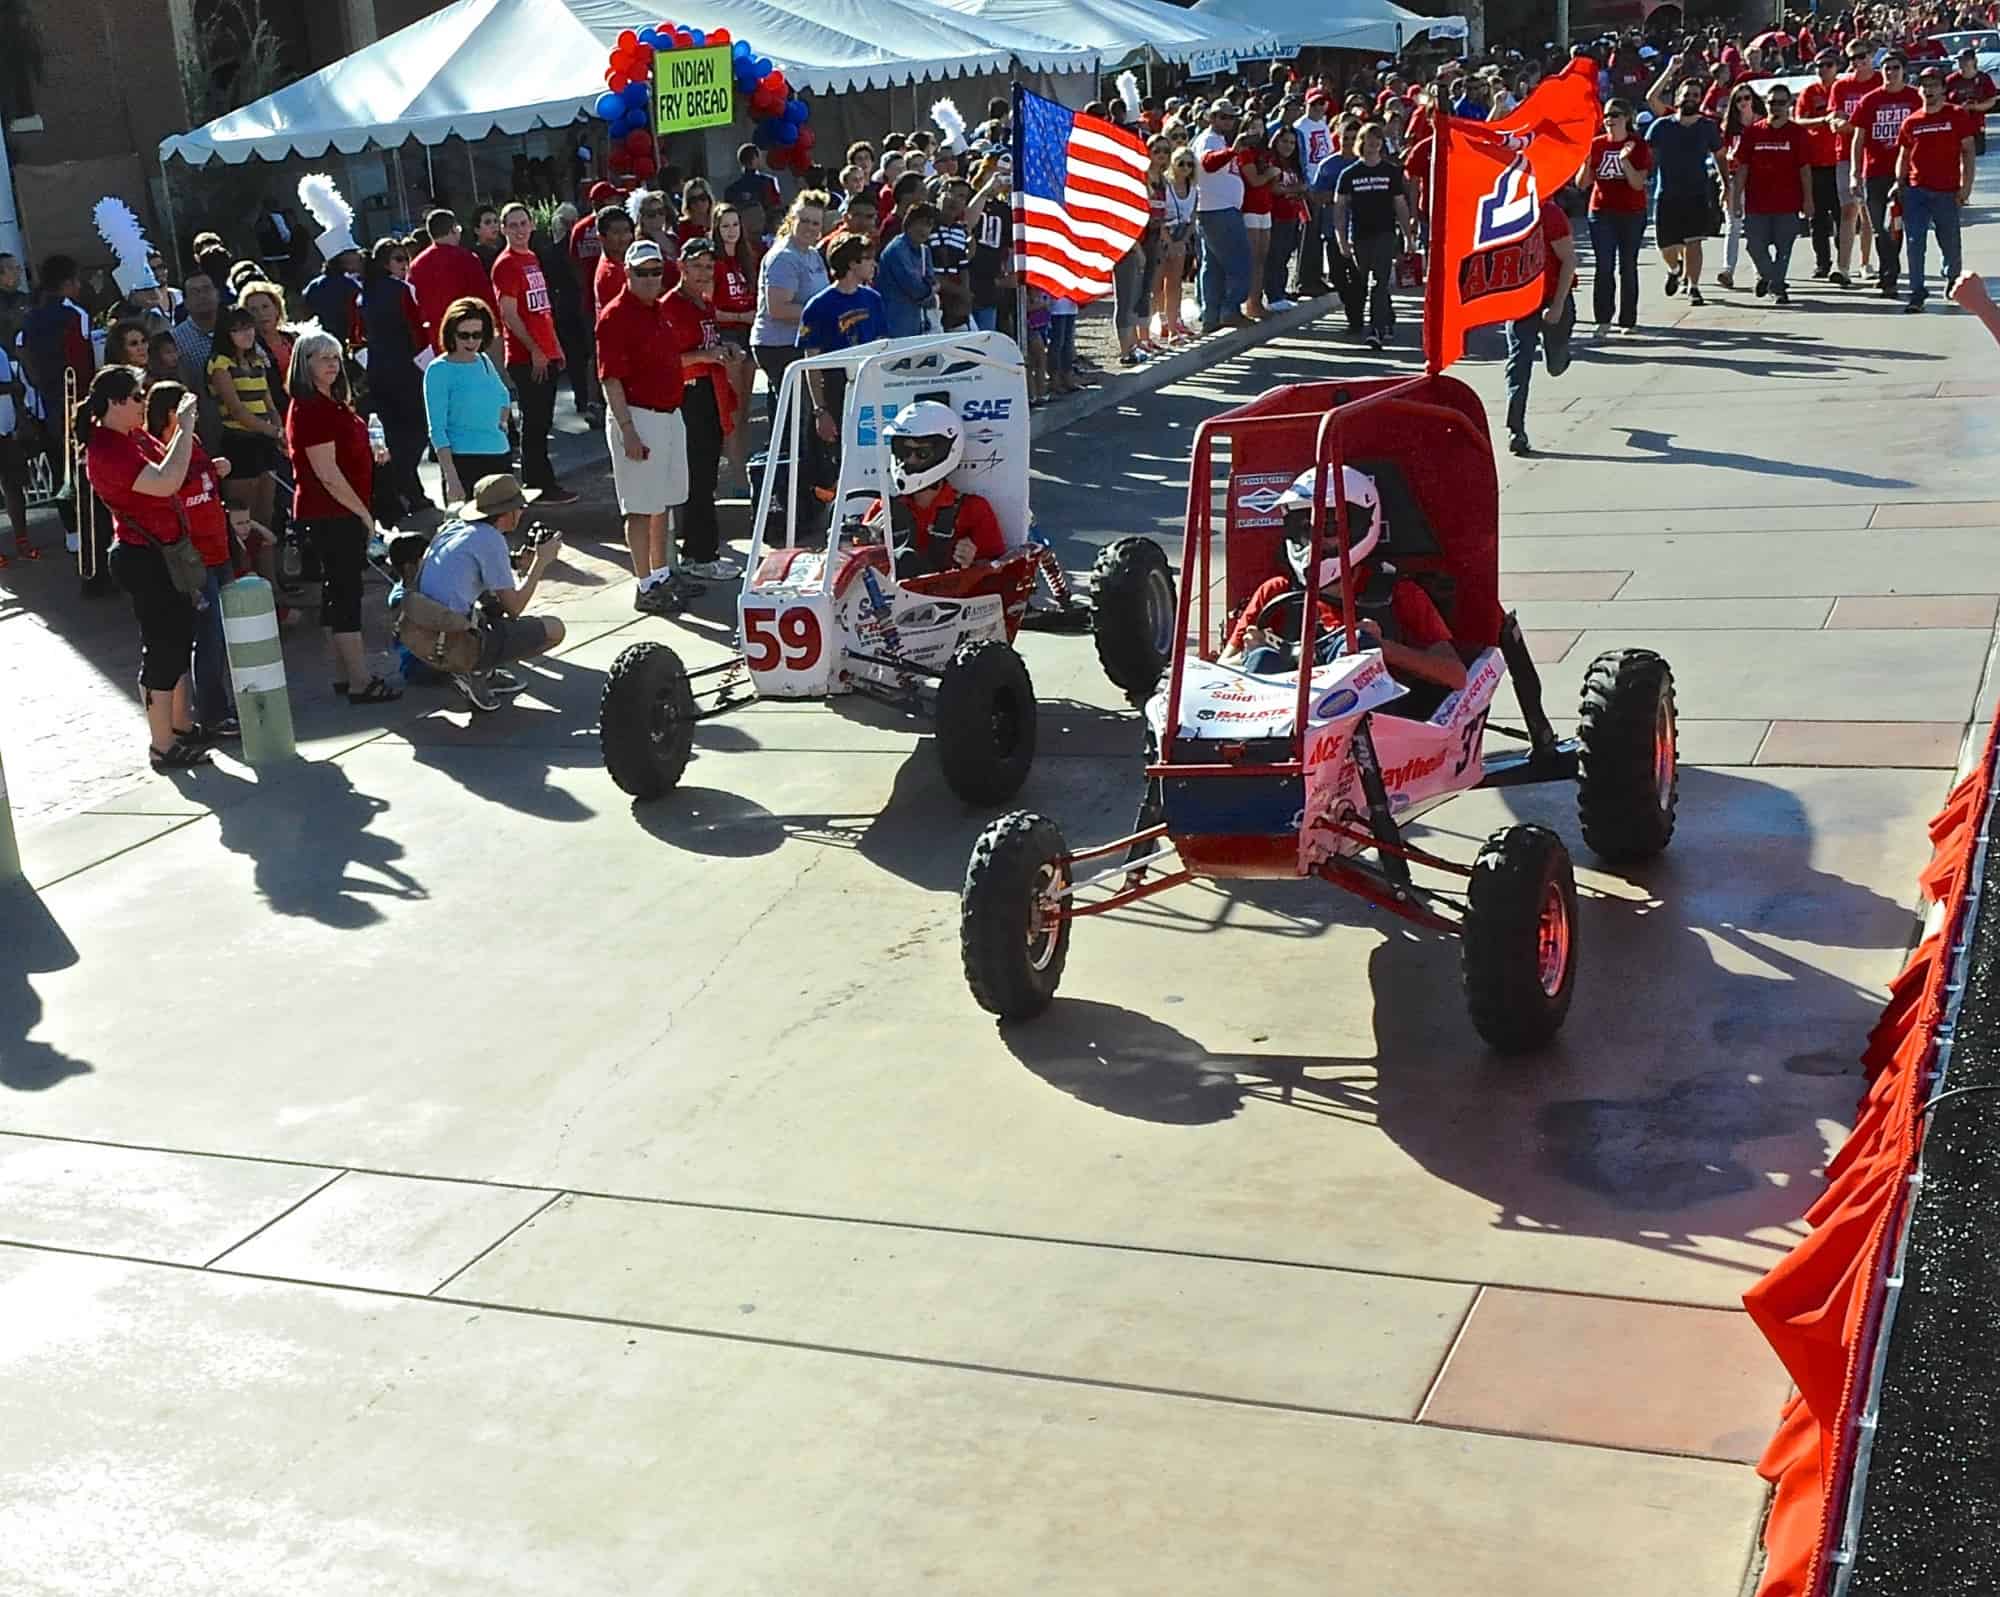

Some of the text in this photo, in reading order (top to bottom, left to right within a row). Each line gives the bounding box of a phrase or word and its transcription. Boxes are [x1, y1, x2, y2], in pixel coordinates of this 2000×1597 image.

[671, 57, 715, 89] INDIAN
[660, 87, 729, 122] FRY BREAD
[1871, 122, 1901, 139] DOW
[961, 398, 1012, 421] SAE
[743, 605, 823, 672] 59
